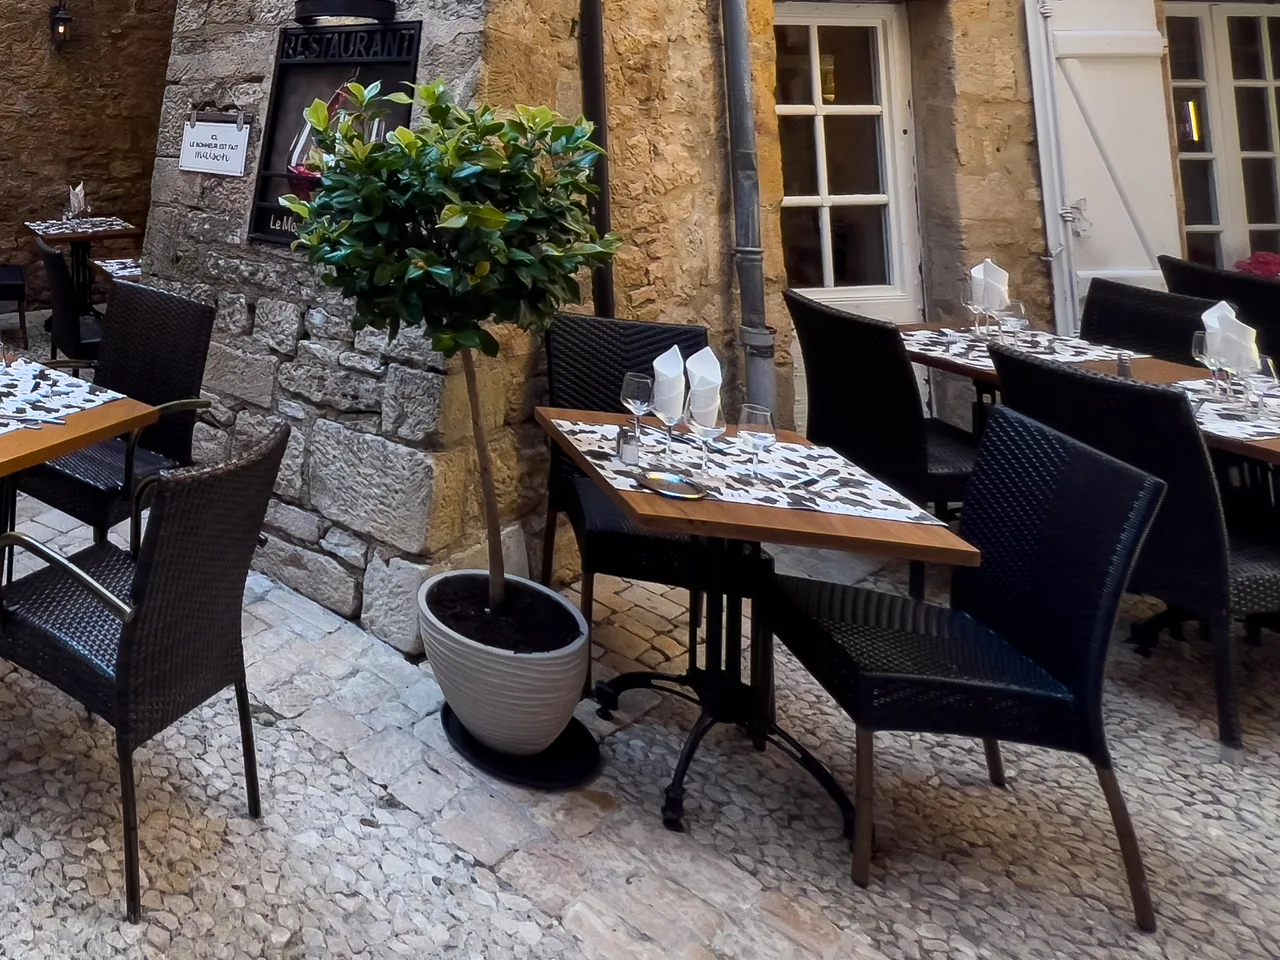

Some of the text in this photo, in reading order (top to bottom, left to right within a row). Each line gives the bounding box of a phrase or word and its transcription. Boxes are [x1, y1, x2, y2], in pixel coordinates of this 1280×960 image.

[282, 29, 416, 61] RESTAURANT
[194, 149, 231, 162] maison
[269, 214, 281, 229] Le
